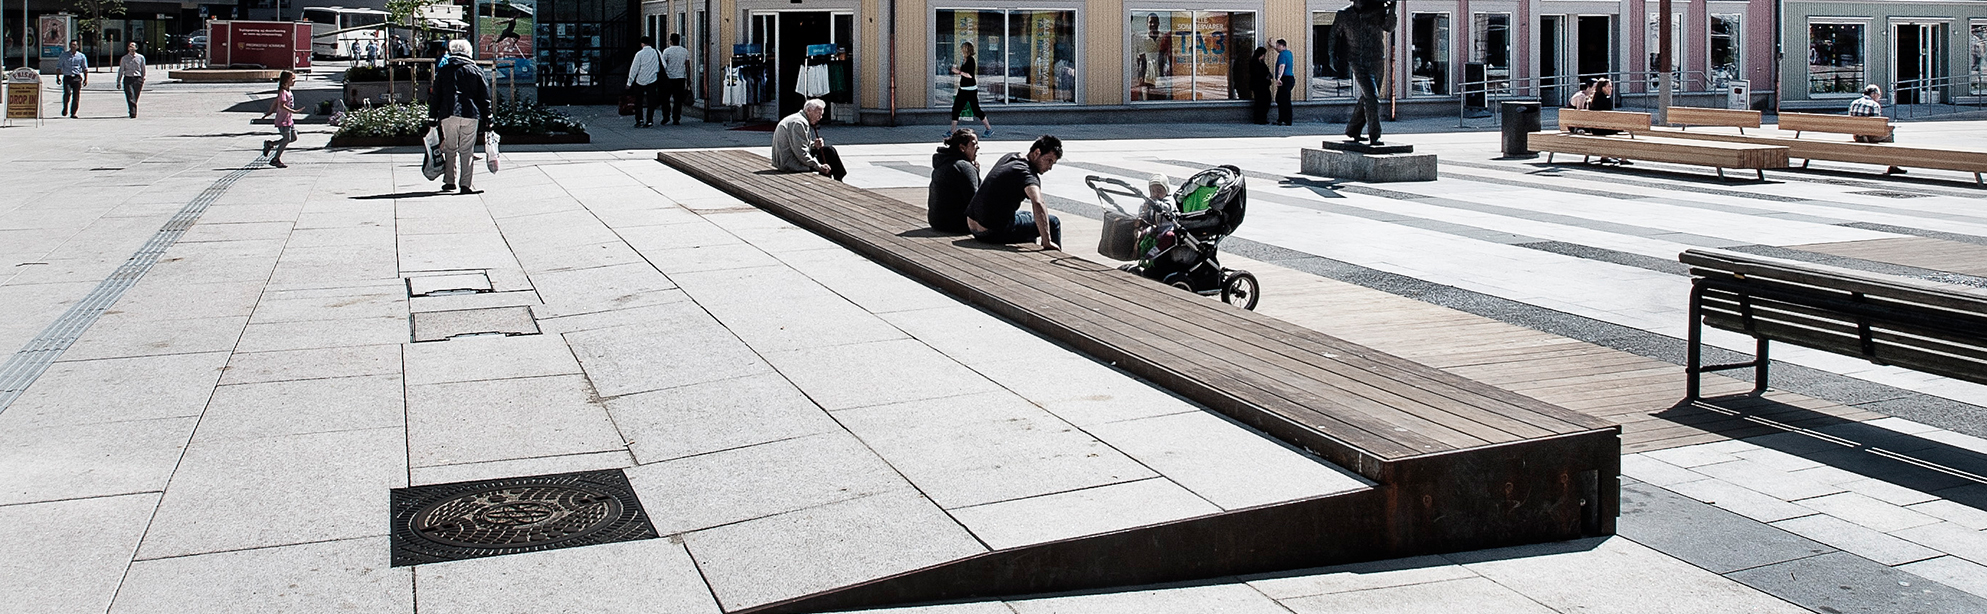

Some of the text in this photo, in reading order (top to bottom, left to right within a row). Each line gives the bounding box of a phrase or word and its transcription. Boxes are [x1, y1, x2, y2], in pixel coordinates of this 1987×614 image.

[1175, 31, 1225, 55] TA 3
[10, 94, 37, 105] DROP IN
